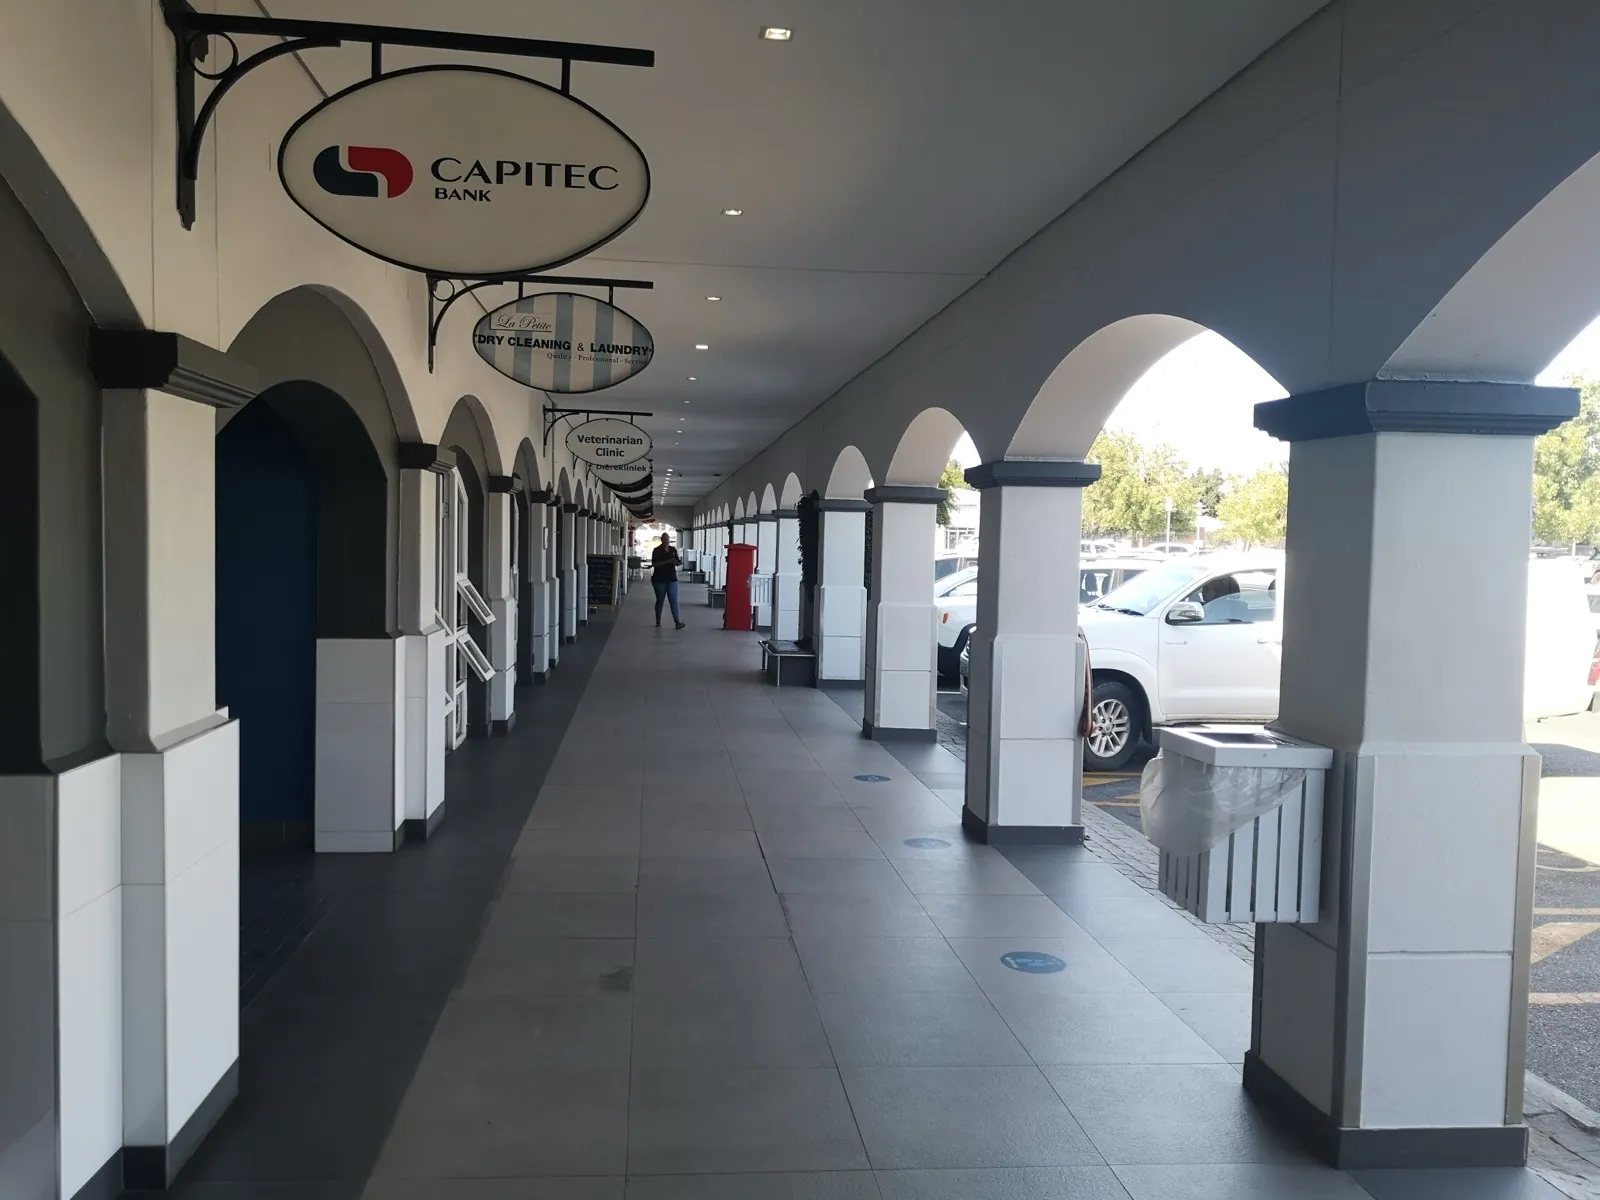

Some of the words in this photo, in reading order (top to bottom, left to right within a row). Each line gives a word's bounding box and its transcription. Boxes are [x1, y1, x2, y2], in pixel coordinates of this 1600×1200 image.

[430, 157, 620, 191] CAPITEC
[434, 187, 492, 203] BANK
[496, 313, 516, 328] La
[519, 315, 552, 330] Petite
[478, 334, 504, 345] DRY
[508, 336, 571, 350] CLEANING
[577, 343, 584, 351] &
[590, 342, 649, 356] LAUNDRY
[547, 352, 572, 362] Quality
[578, 354, 619, 363] Professional
[577, 434, 643, 445] Veterinarian
[595, 447, 625, 457] Clinic
